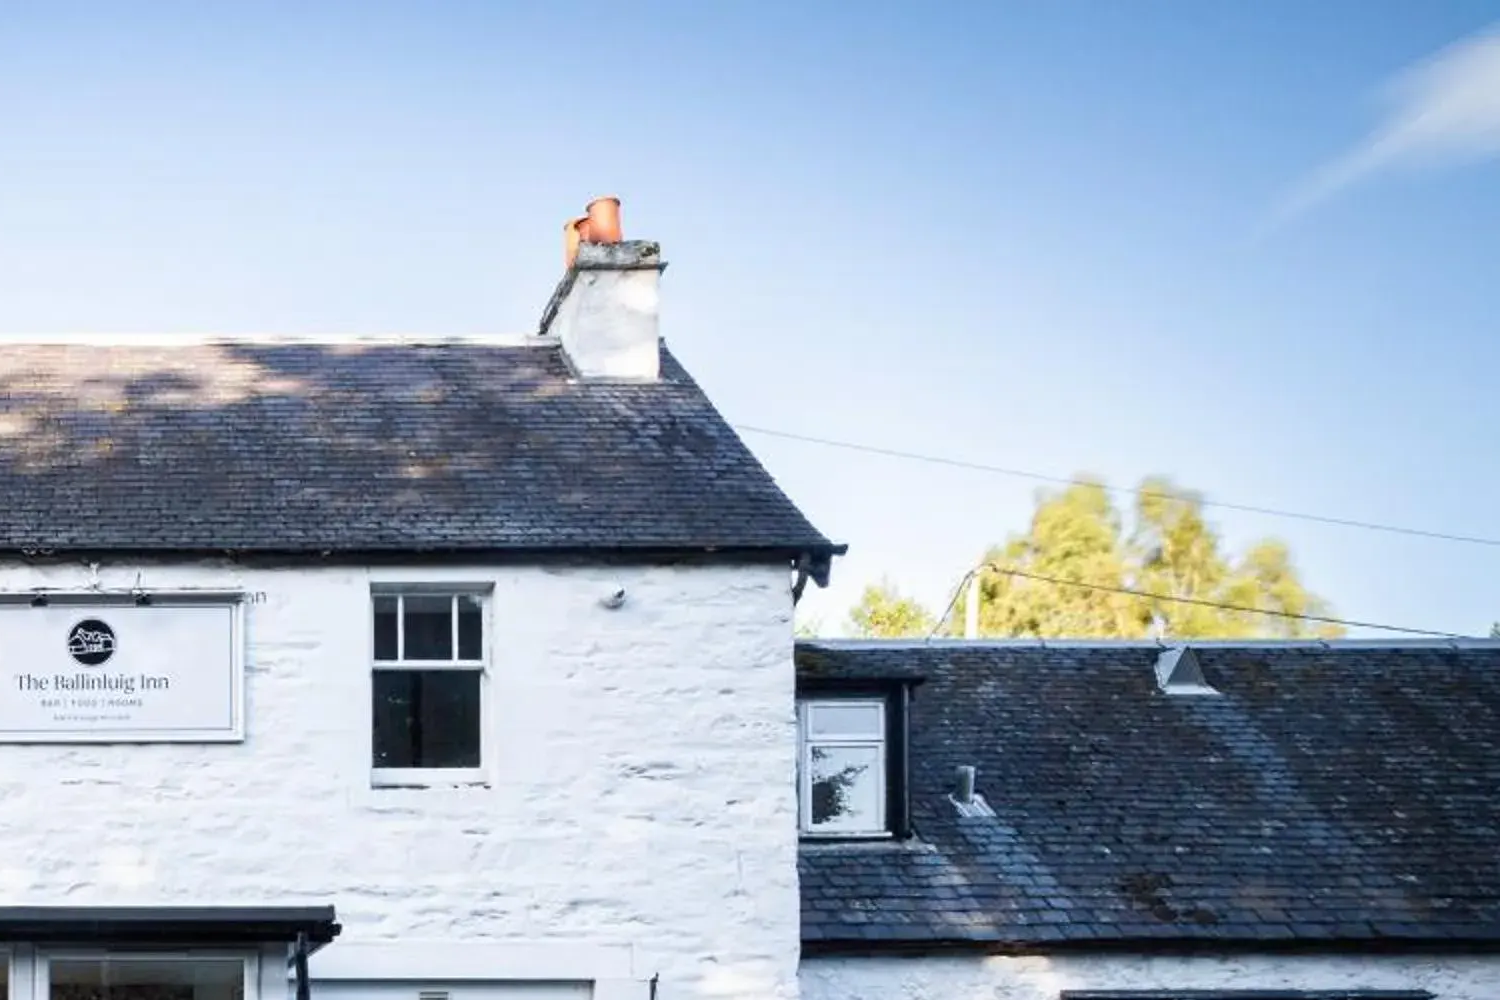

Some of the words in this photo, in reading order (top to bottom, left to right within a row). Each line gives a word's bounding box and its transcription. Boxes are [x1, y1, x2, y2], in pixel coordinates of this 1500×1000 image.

[15, 674, 49, 691] The
[54, 673, 135, 694] Ballinluig
[141, 674, 170, 690] Inn
[108, 698, 143, 707] ROOMS
